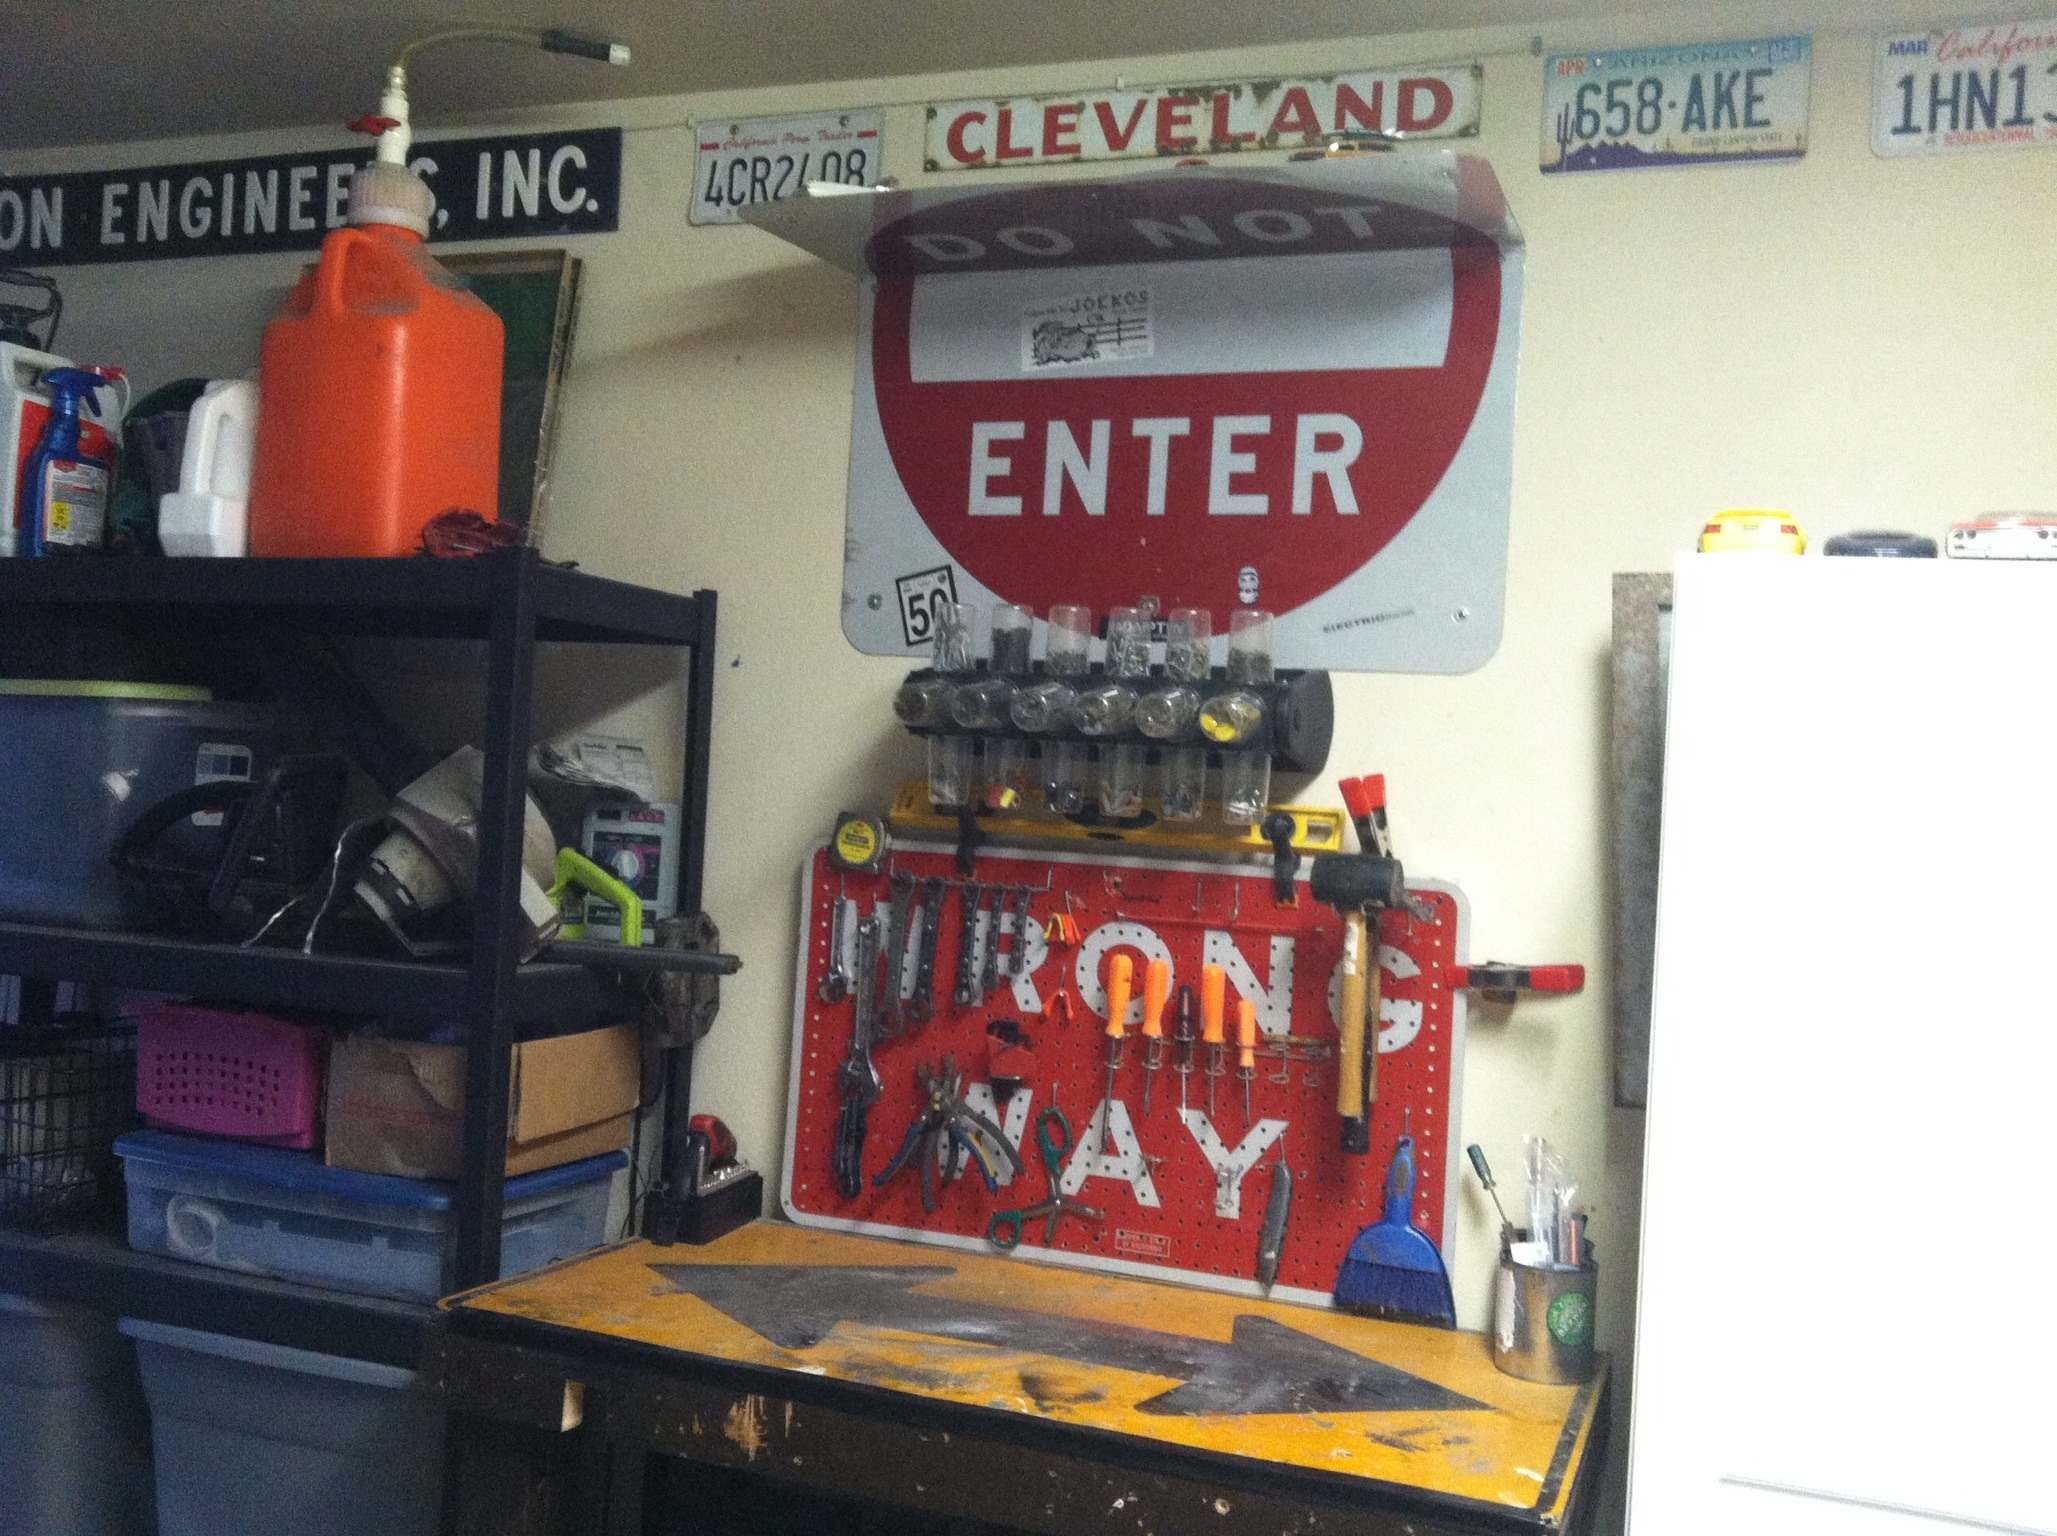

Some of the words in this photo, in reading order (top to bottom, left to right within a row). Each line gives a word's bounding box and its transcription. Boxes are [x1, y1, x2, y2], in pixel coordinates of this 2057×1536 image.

[1556, 58, 1587, 77] APR
[1888, 38, 1928, 56] MAR
[946, 77, 1455, 163] CLEVELAND
[101, 157, 450, 245] ENGINEES,
[475, 145, 599, 220] INC.
[903, 225, 1075, 263] DO
[1131, 206, 1384, 248] NOT
[967, 413, 1364, 517] ENTER
[907, 588, 953, 637] 50
[833, 898, 1424, 1054] WRONG
[932, 1081, 1290, 1220] WAY
